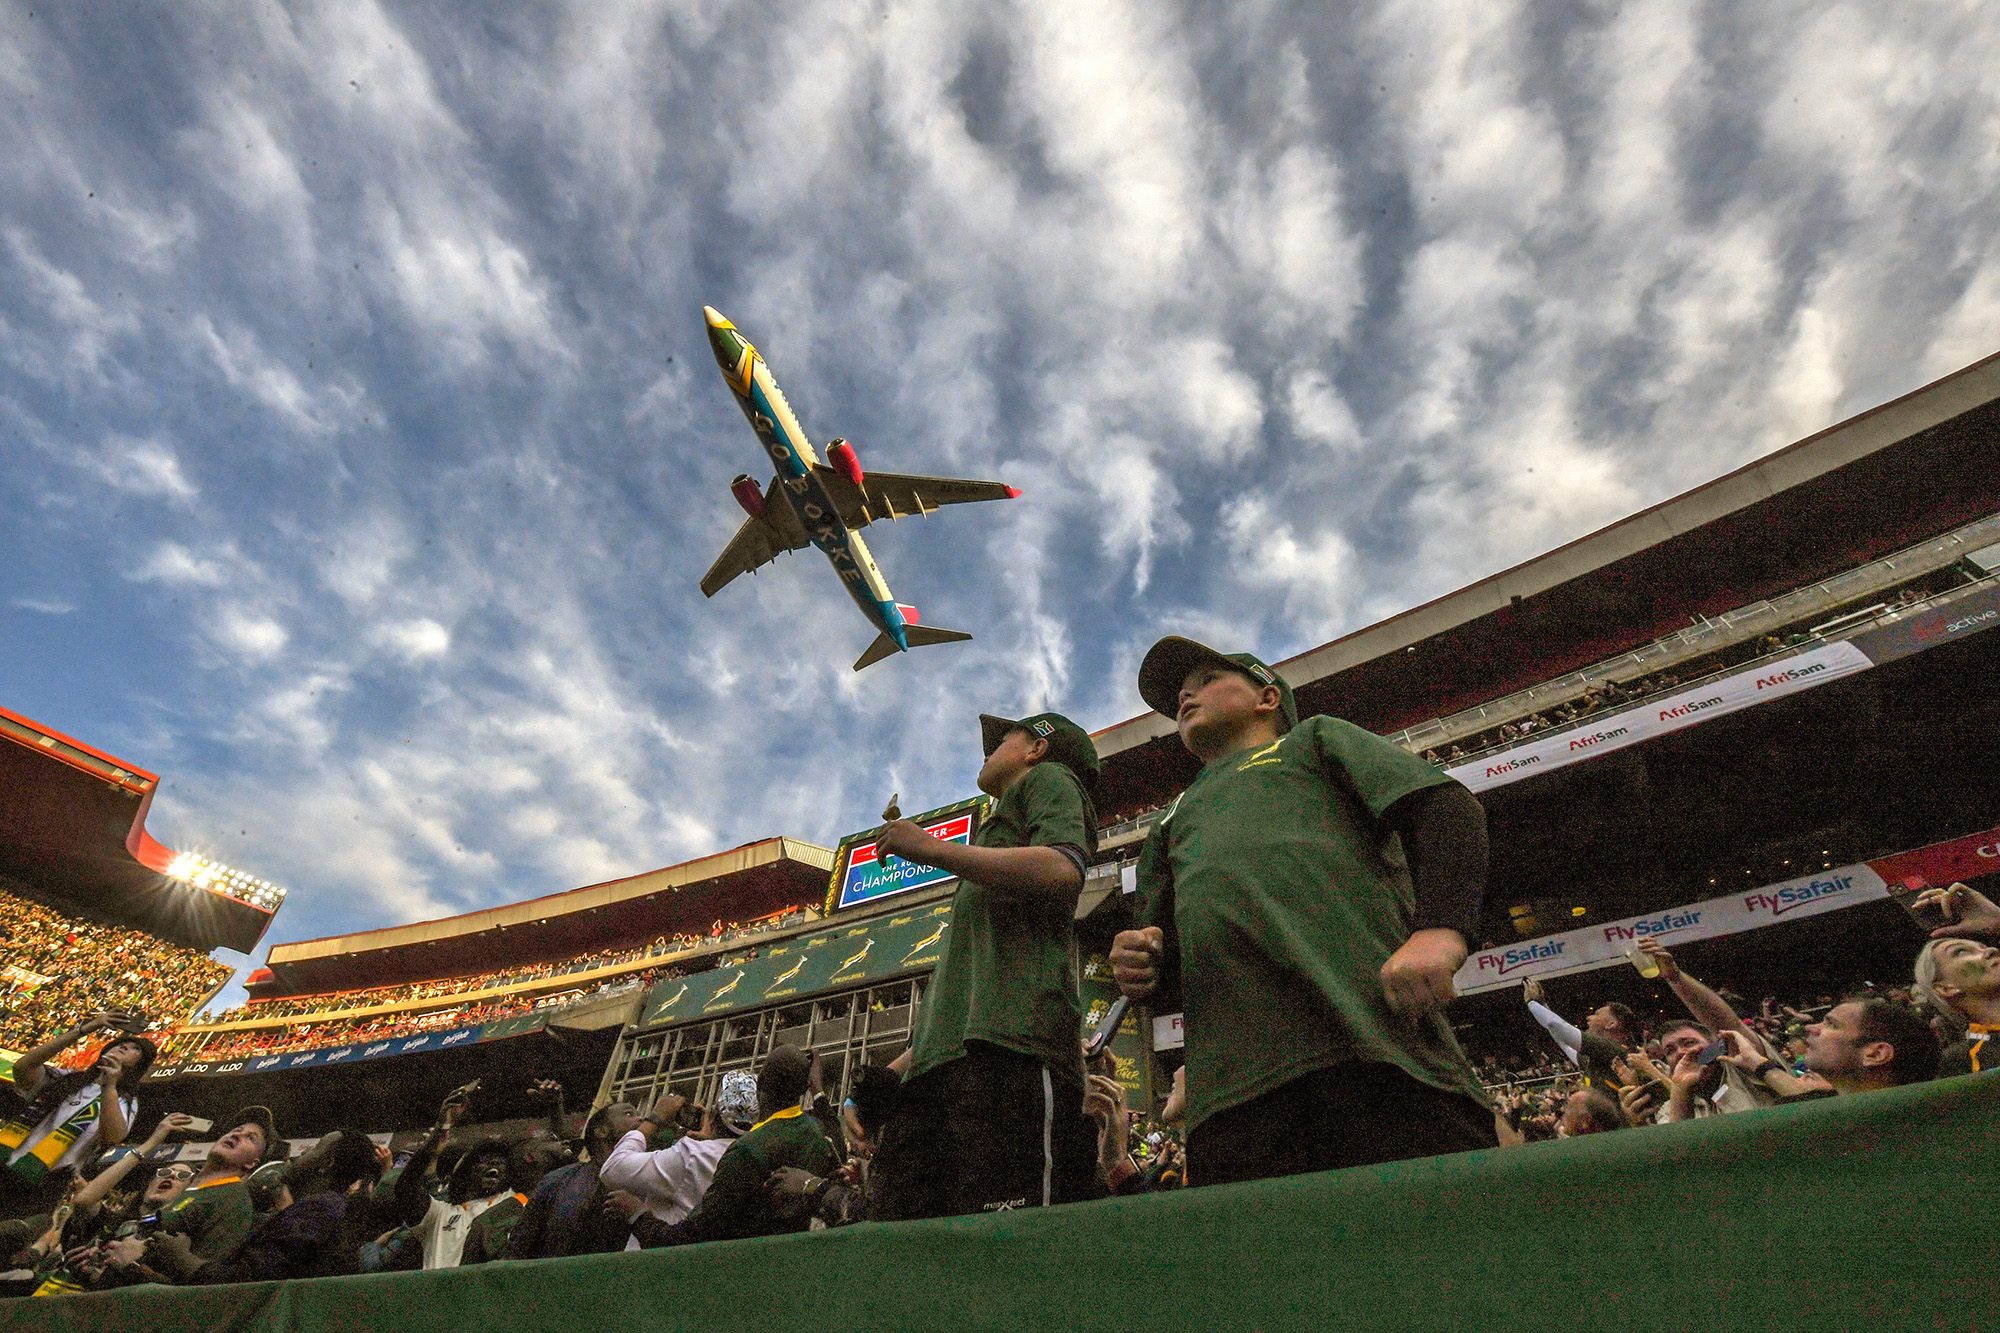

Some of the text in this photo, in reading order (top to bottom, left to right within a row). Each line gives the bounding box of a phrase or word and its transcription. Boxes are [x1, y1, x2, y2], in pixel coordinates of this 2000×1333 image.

[790, 479, 861, 581] BOKKE
[1946, 610, 1998, 632] active
[1756, 662, 1826, 690] AfriSam
[1659, 695, 1723, 721] AfriSam
[1569, 727, 1628, 751] AfriSam
[1486, 755, 1540, 778] AfriSam
[853, 864, 937, 892] CHAMPIONS
[881, 863, 898, 873] THE
[1744, 875, 1852, 915] FlySafair
[1603, 911, 1701, 943] FlySafair
[1478, 940, 1566, 974] FlySafair
[151, 1068, 176, 1078] ALDO
[181, 1064, 208, 1074] ALDO
[216, 1062, 243, 1072] ALDO
